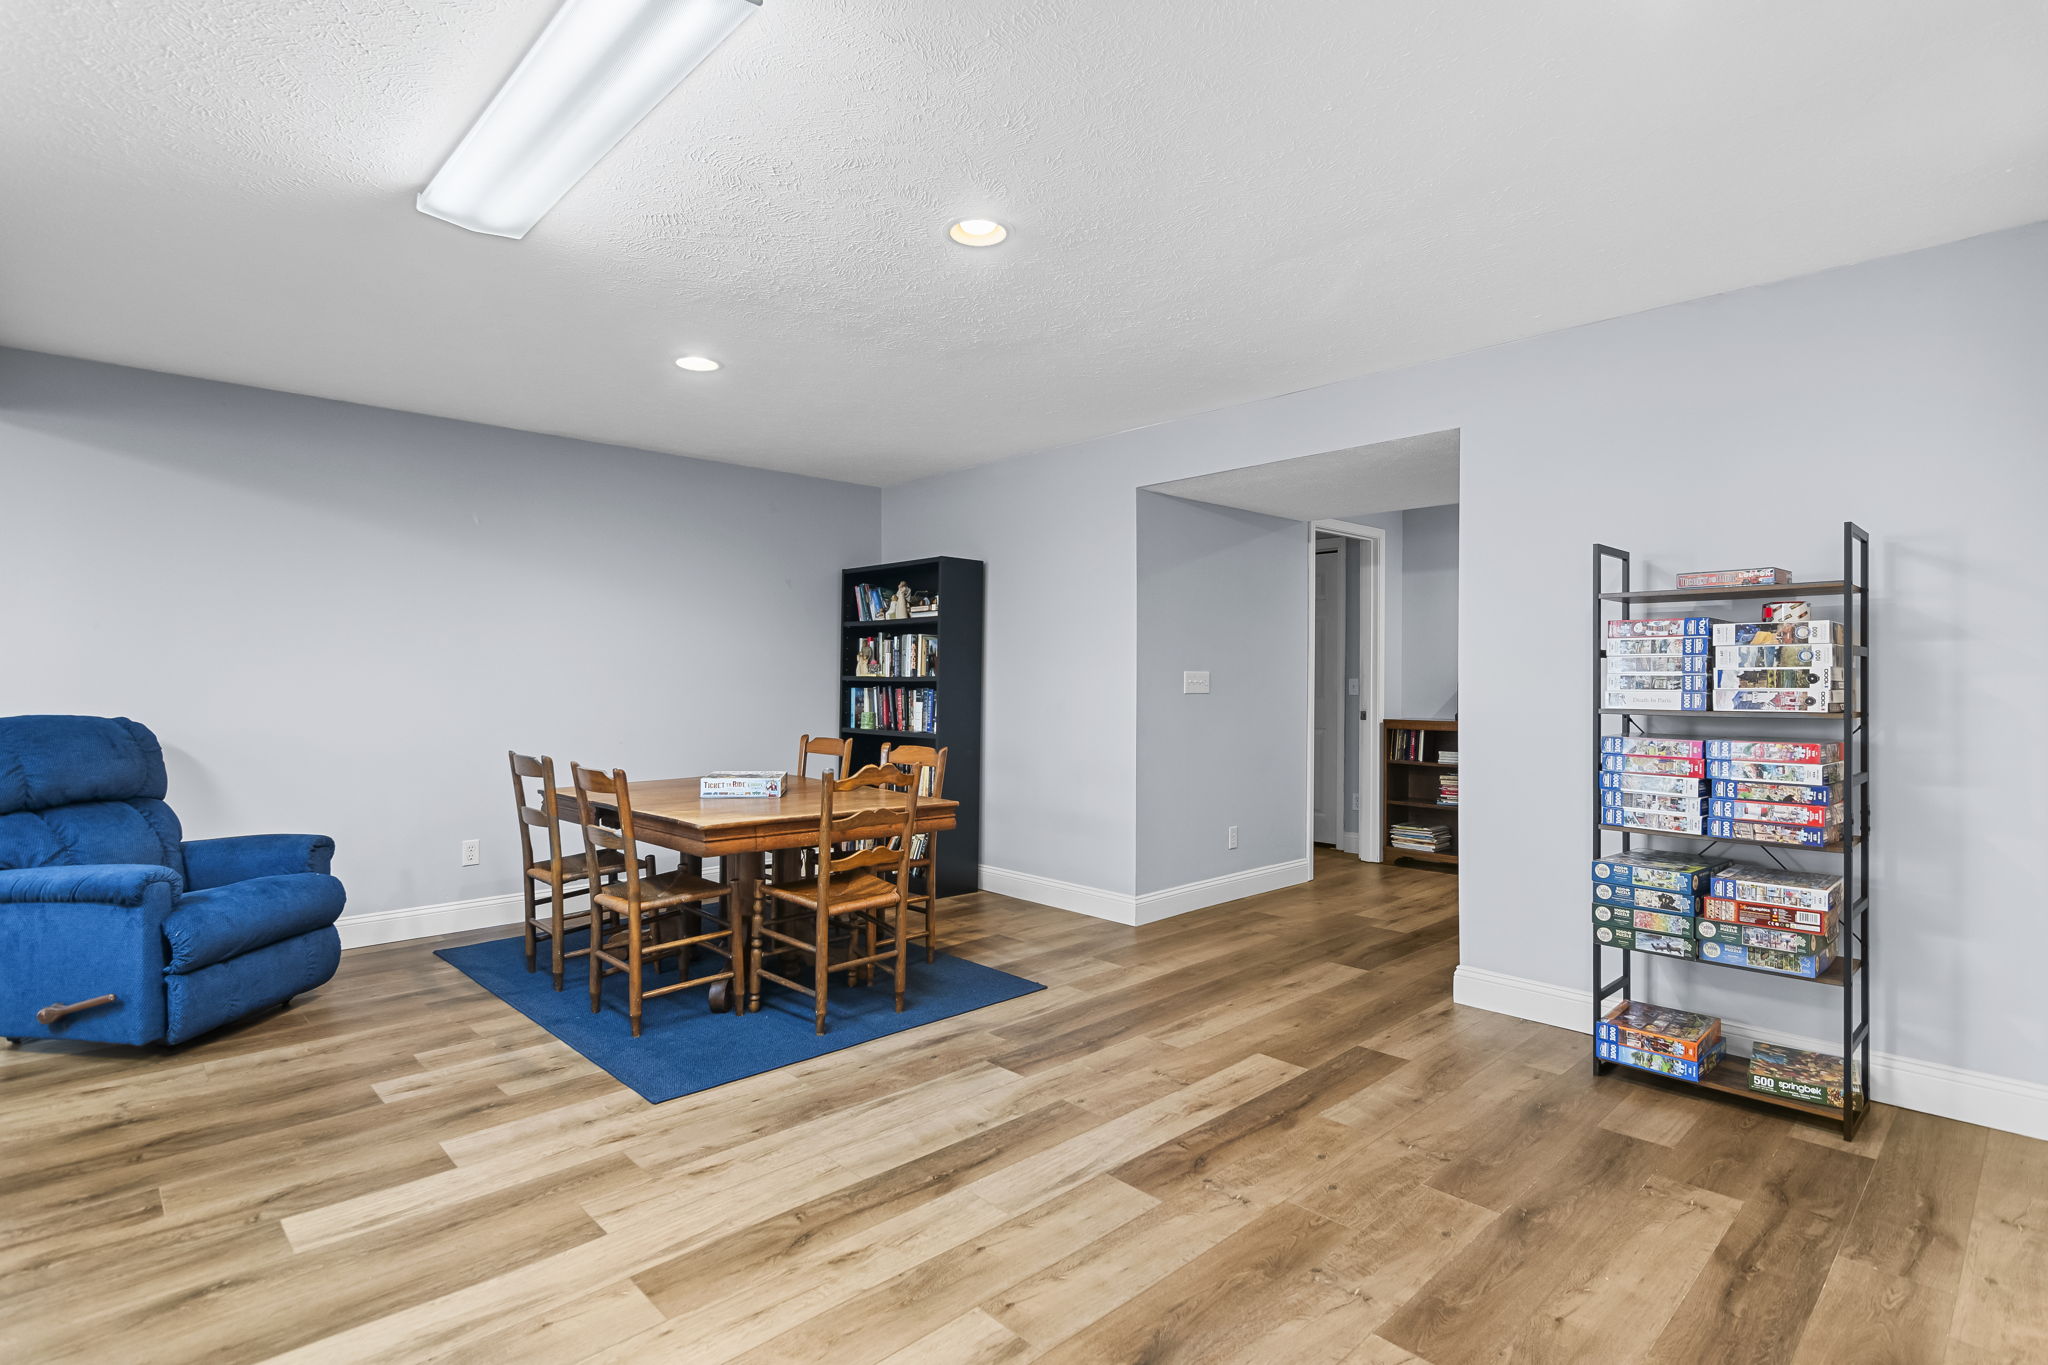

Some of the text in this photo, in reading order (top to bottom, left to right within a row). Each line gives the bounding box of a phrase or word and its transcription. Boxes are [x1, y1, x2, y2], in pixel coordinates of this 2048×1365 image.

[1684, 638, 1692, 654] 1000
[1753, 1075, 1775, 1088] 500
[1778, 1081, 1822, 1095] springbok
